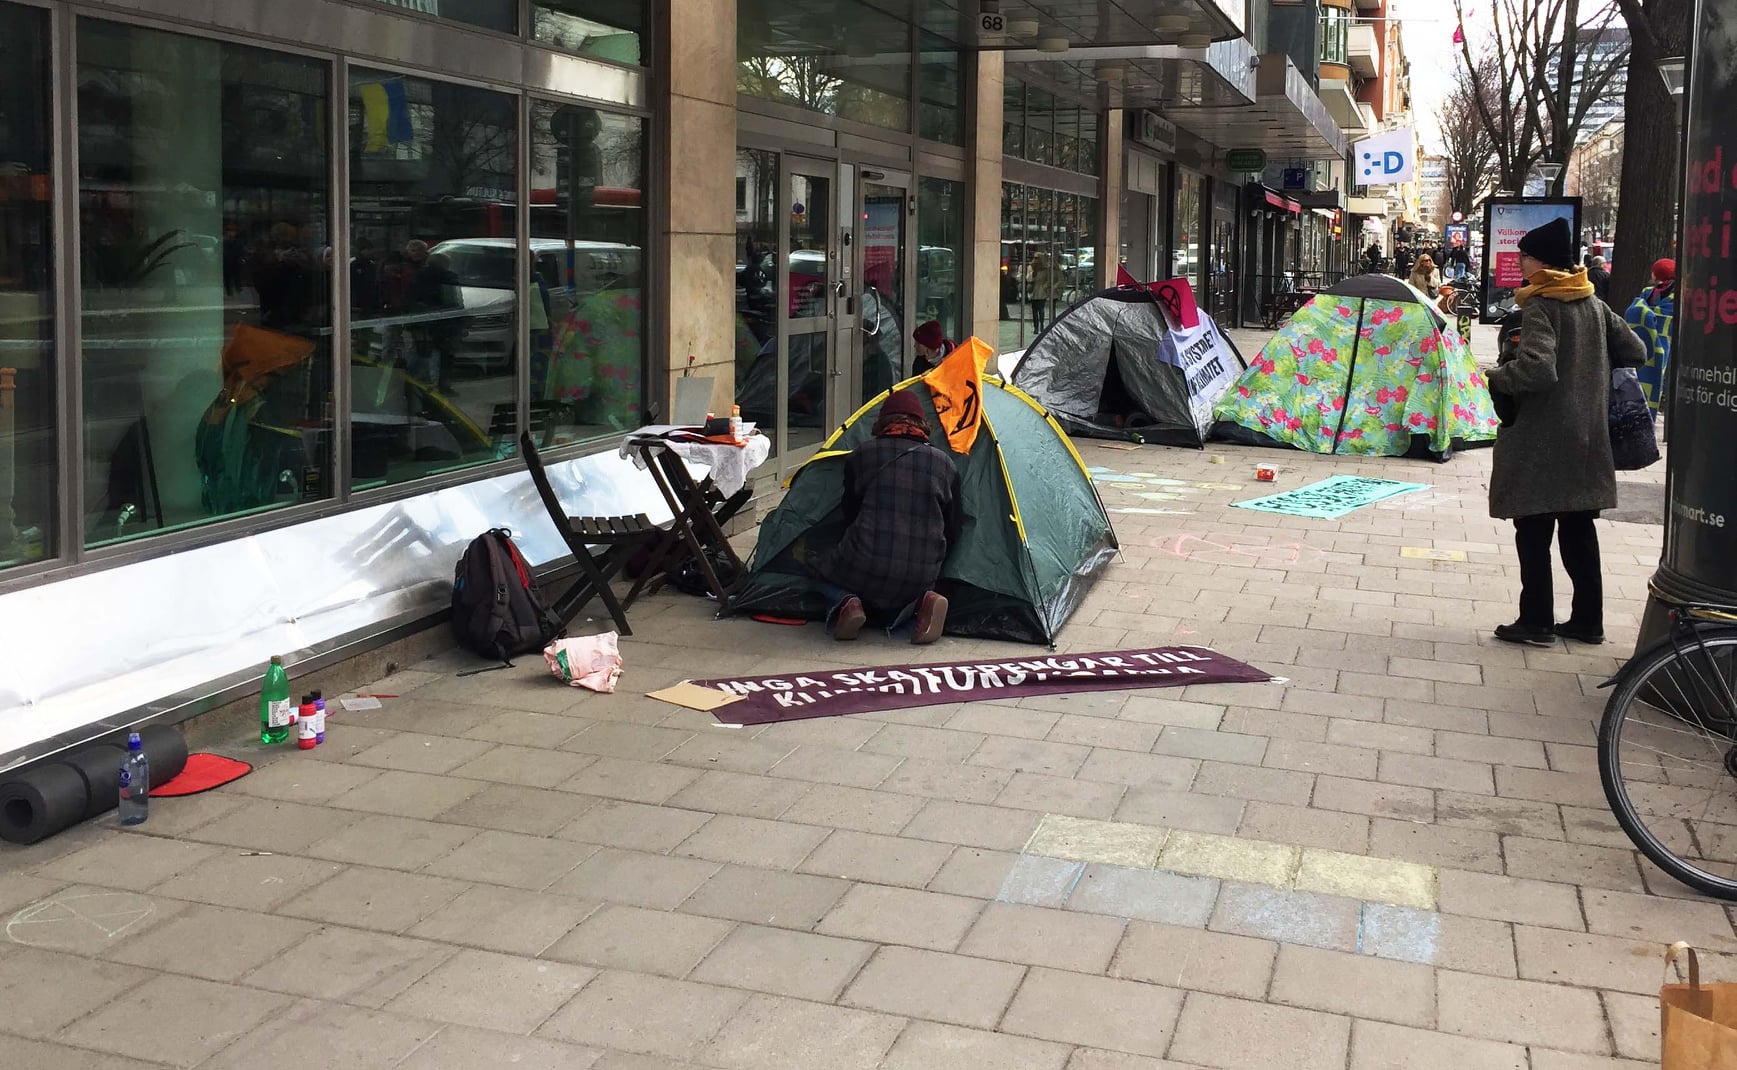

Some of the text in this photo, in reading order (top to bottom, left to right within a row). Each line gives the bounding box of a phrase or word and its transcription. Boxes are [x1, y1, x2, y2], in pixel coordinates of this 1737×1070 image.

[982, 15, 1003, 31] 68
[1696, 385, 1715, 405] för
[717, 676, 827, 696] INGA
[1130, 650, 1213, 666] TILL
